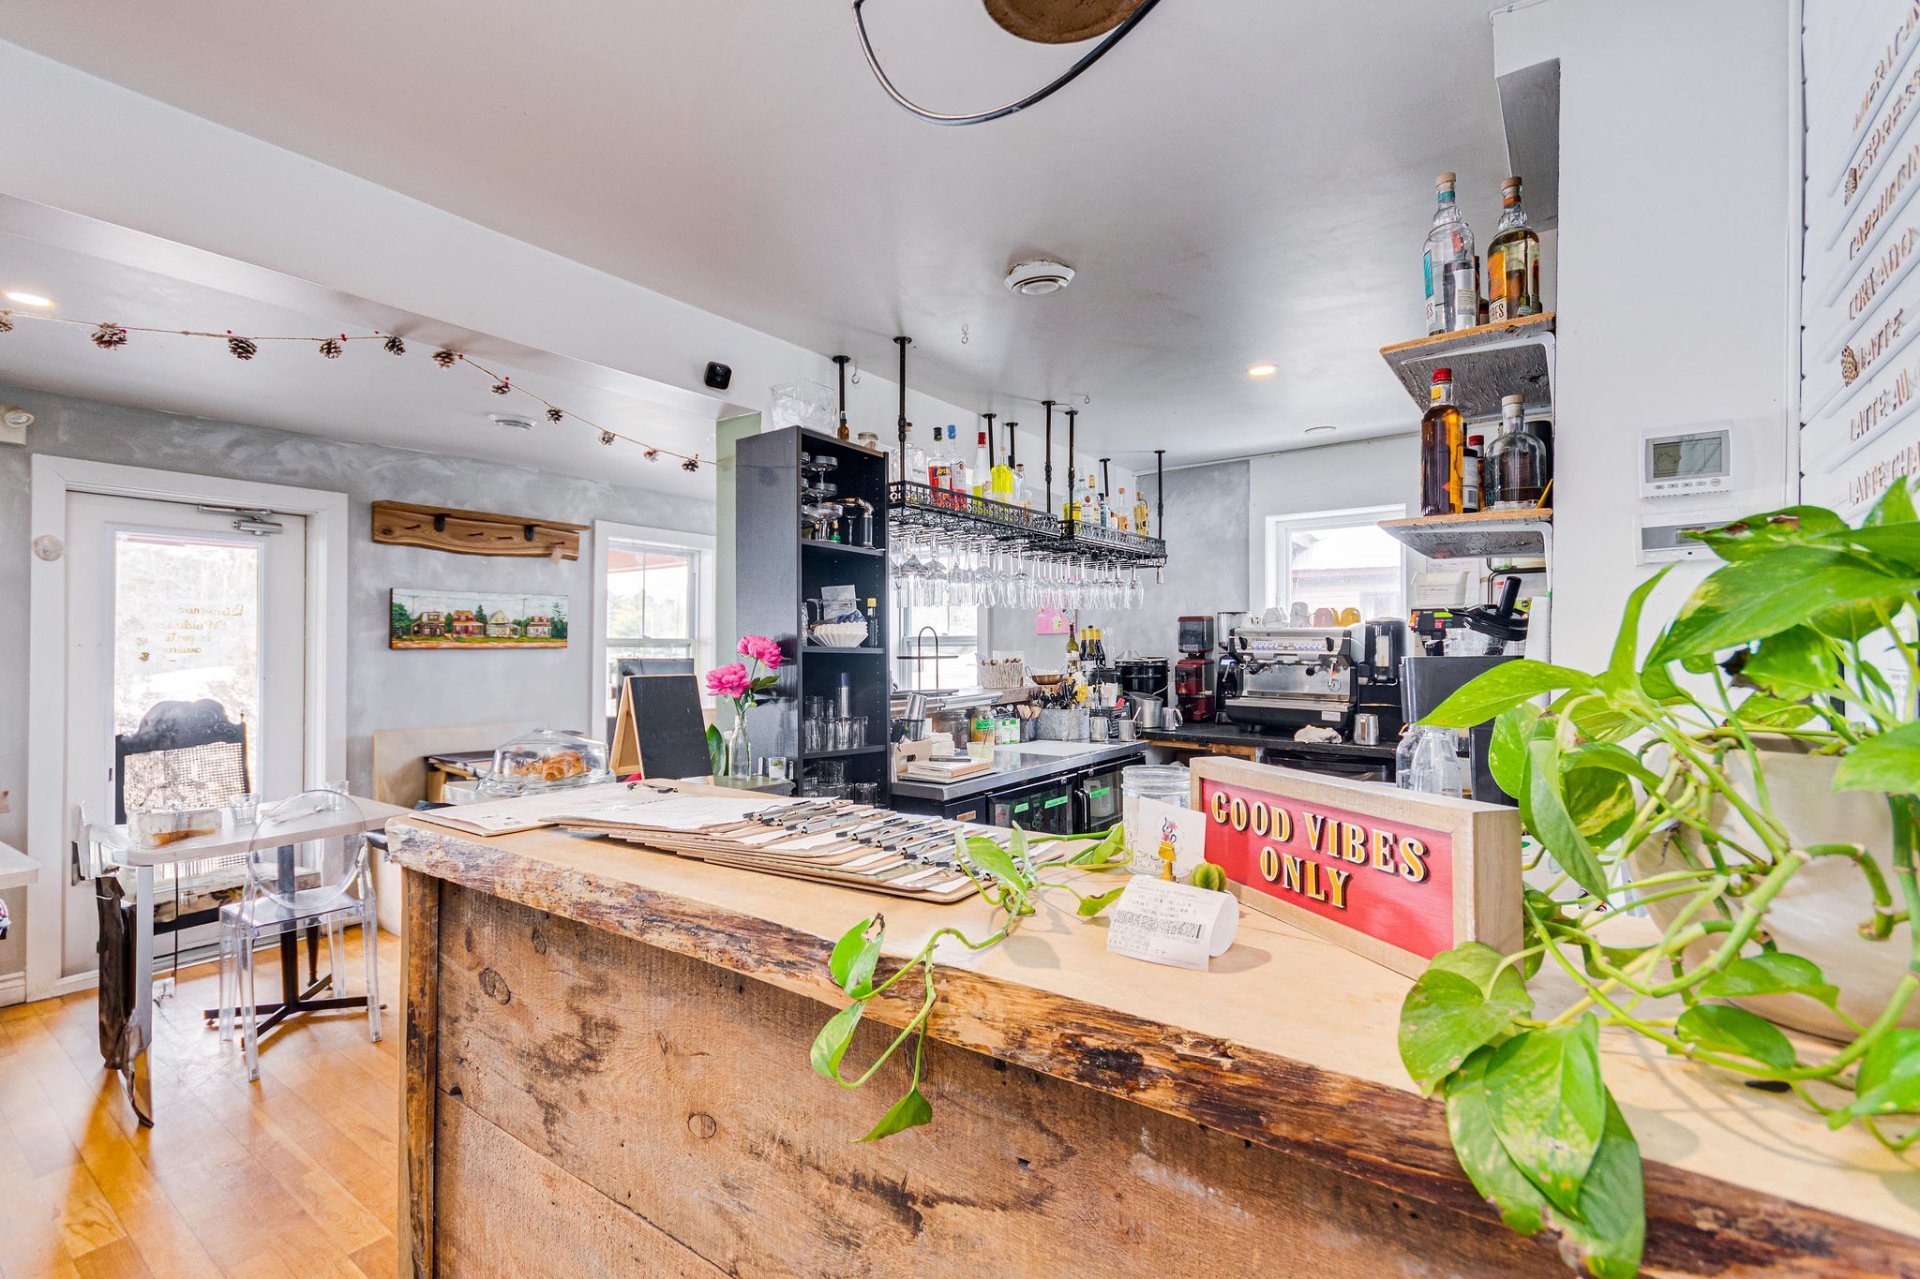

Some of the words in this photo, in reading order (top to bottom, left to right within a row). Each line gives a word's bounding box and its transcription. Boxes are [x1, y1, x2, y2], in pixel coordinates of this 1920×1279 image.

[1860, 307, 1904, 370] LATTE
[1850, 388, 1890, 442] LATTE
[1849, 461, 1889, 506] LATTE
[1211, 791, 1294, 843] GOOD
[1303, 811, 1429, 884] VIBES
[1260, 846, 1351, 909] ONLY
